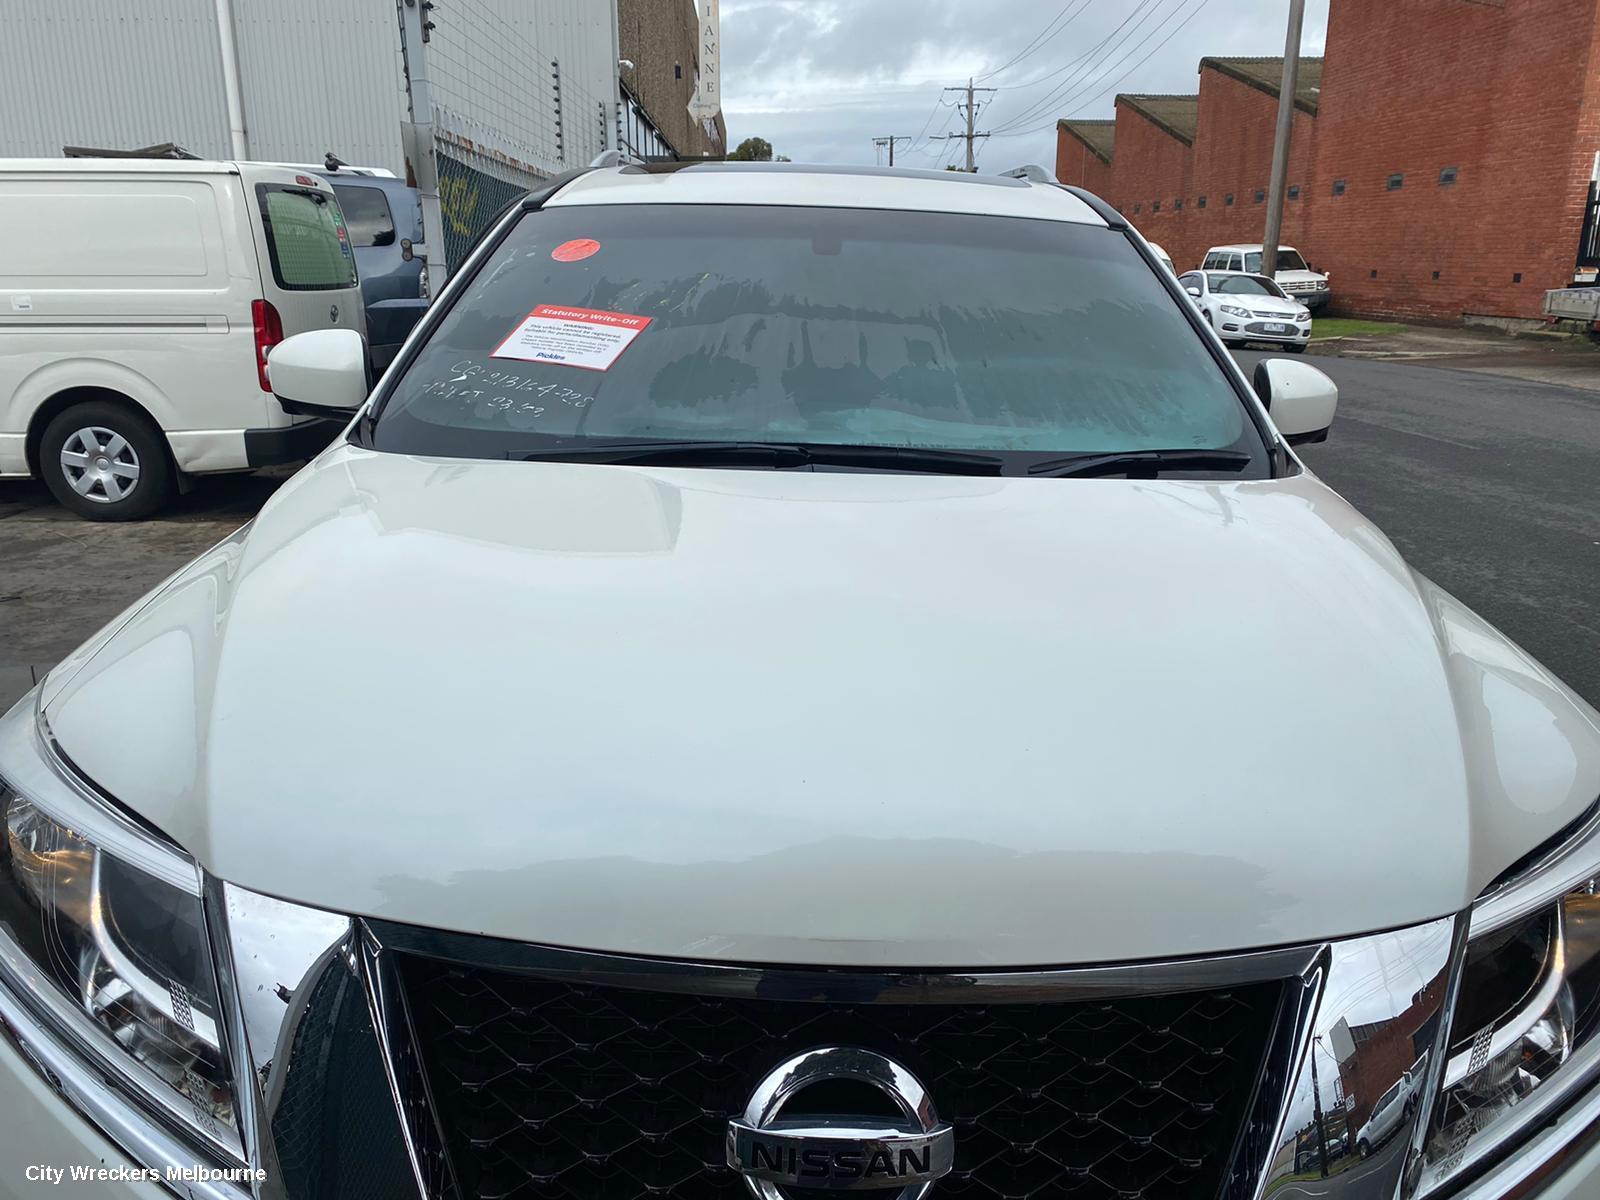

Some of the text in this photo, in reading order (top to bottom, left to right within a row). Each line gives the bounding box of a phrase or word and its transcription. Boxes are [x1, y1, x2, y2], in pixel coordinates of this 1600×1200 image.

[541, 308, 640, 326] Statutory Write-Off
[536, 352, 565, 360] Pickles
[751, 1141, 931, 1178] NISSAN
